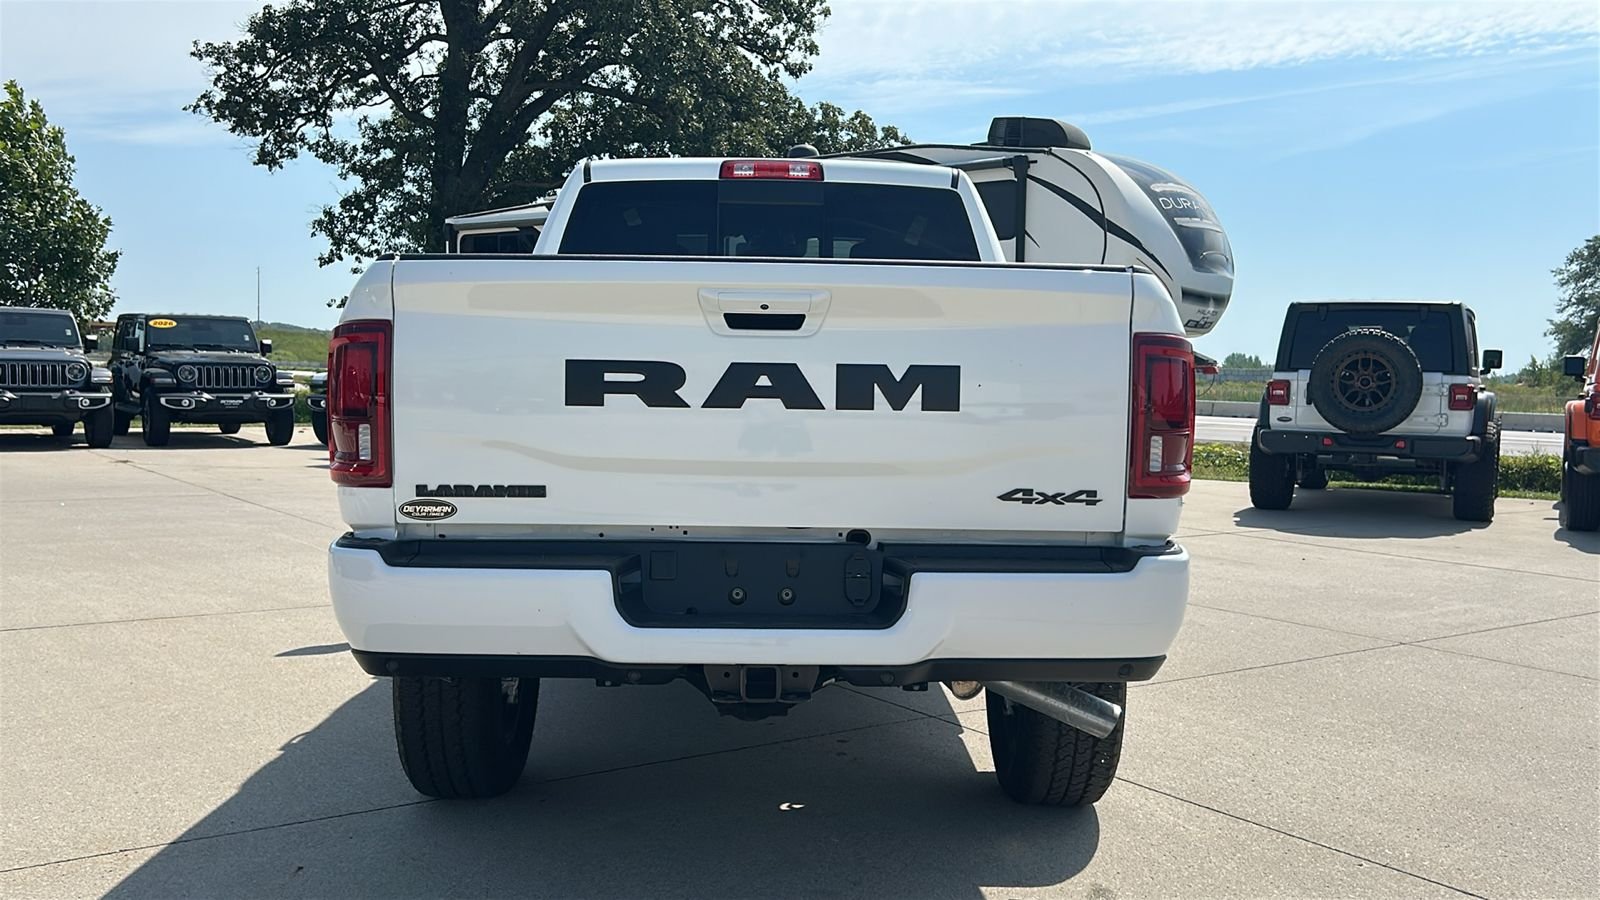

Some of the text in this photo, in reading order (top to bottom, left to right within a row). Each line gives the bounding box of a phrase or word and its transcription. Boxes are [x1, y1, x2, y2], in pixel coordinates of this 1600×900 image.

[564, 359, 961, 412] RAM
[416, 484, 547, 498] LARAMIE
[996, 488, 1103, 506] 4x4
[402, 505, 452, 513] DEYARMAN
